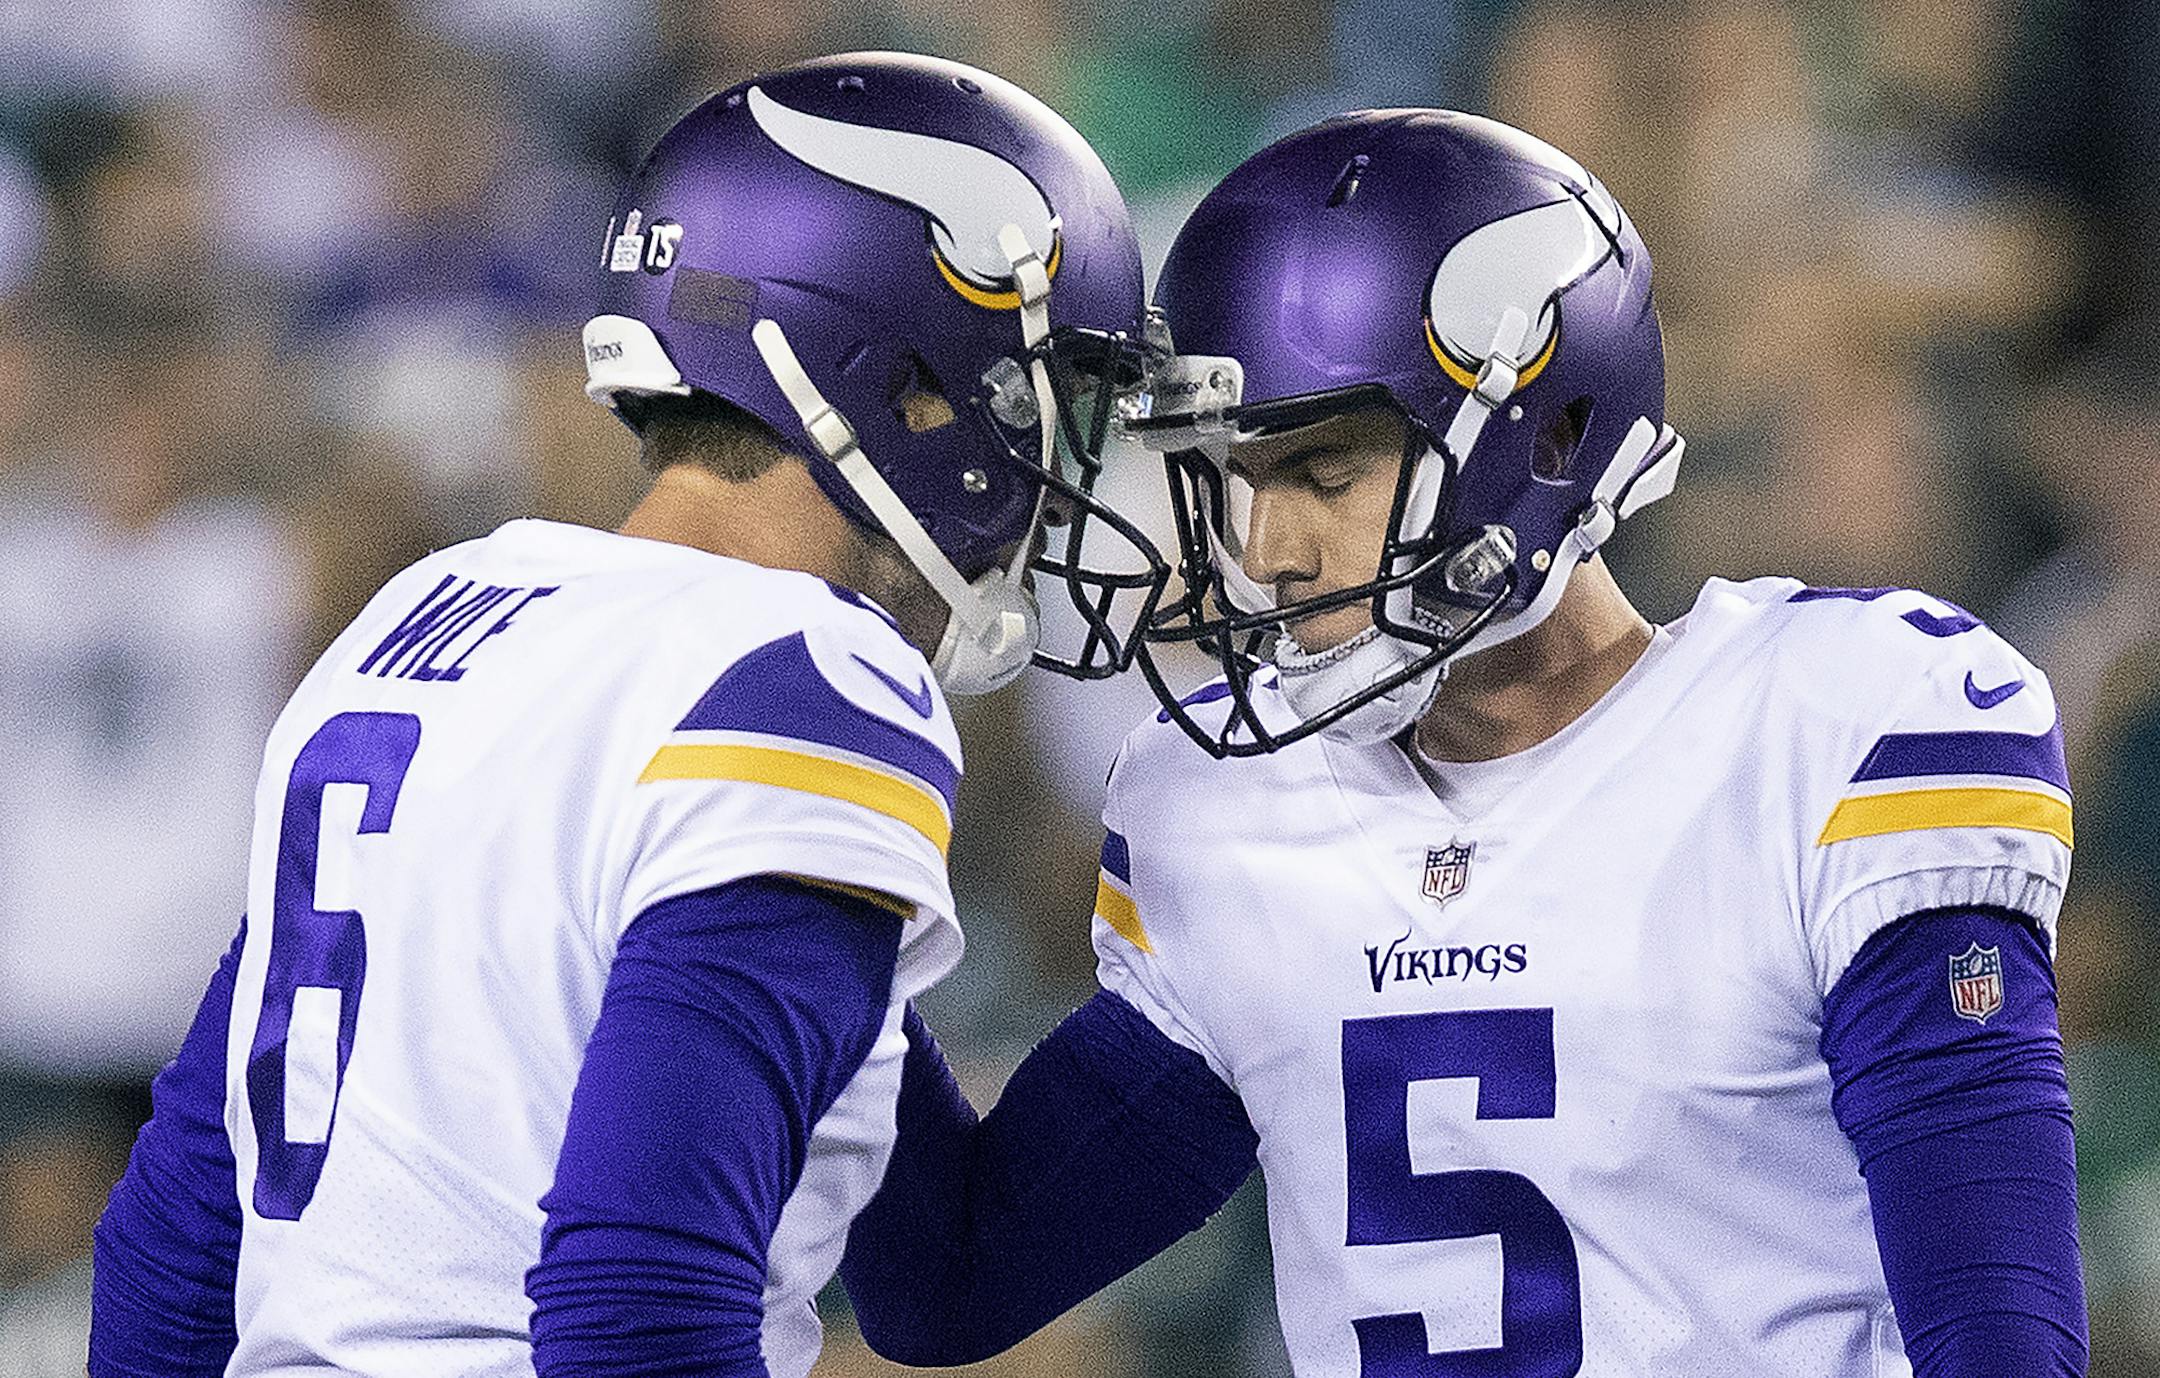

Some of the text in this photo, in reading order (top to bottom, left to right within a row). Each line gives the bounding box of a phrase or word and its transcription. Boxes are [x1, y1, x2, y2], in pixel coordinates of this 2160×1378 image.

[357, 574, 561, 682] WILE
[1427, 866, 1462, 896] NFL
[246, 711, 421, 1222] 6
[1957, 977, 1999, 1012] NFL
[1341, 1007, 1583, 1378] 5
